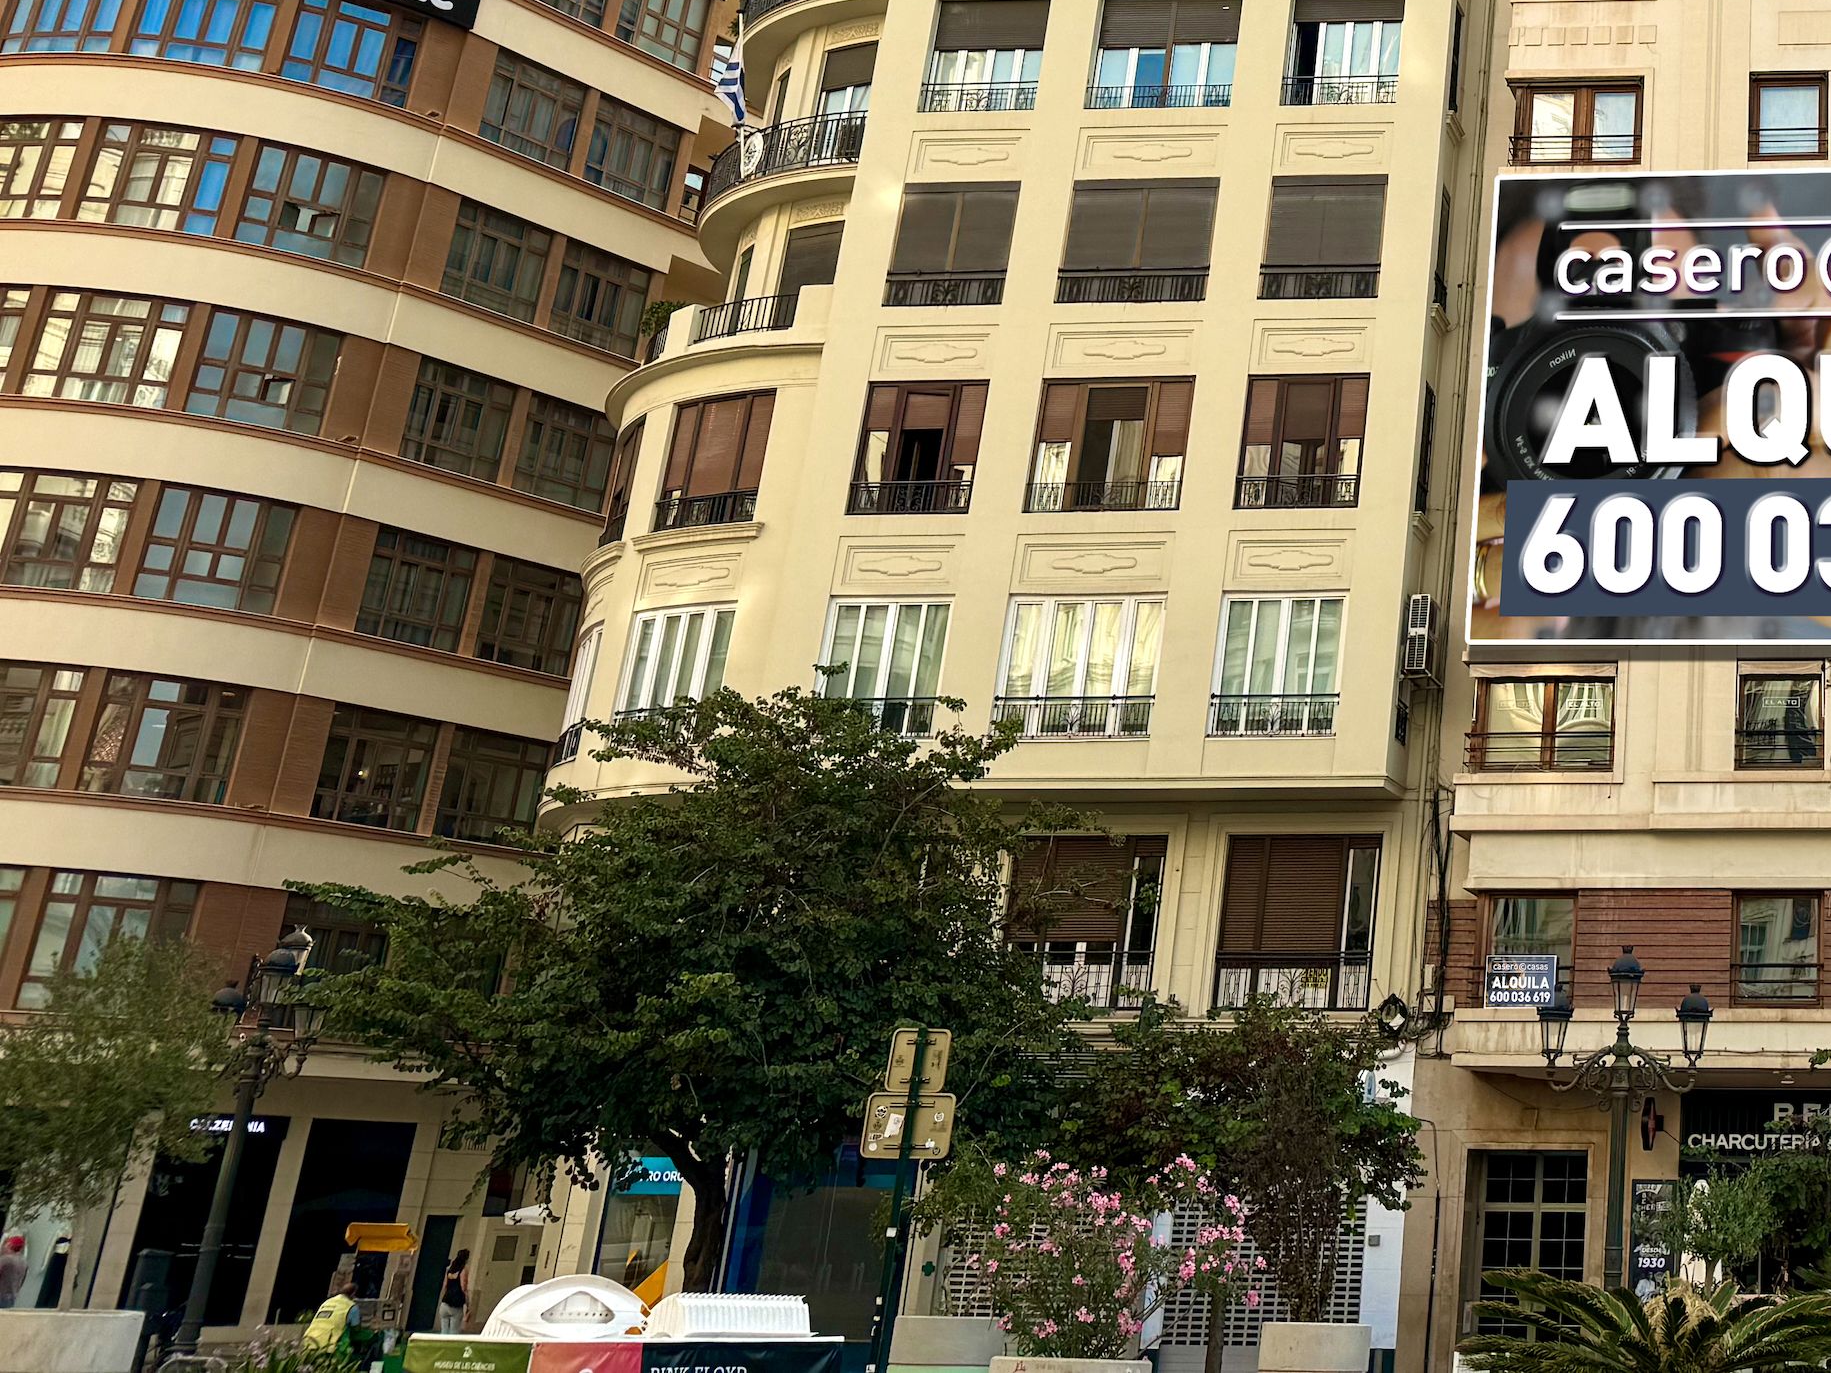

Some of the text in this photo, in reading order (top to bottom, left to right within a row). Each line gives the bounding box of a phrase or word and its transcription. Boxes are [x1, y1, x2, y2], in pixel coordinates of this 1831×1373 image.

[1555, 243, 1805, 297] casero
[1522, 493, 1723, 596] 600
[1492, 976, 1550, 989] ALQUILA
[1490, 991, 1551, 1003] 600 036 619
[1638, 1257, 1666, 1268] 1930
